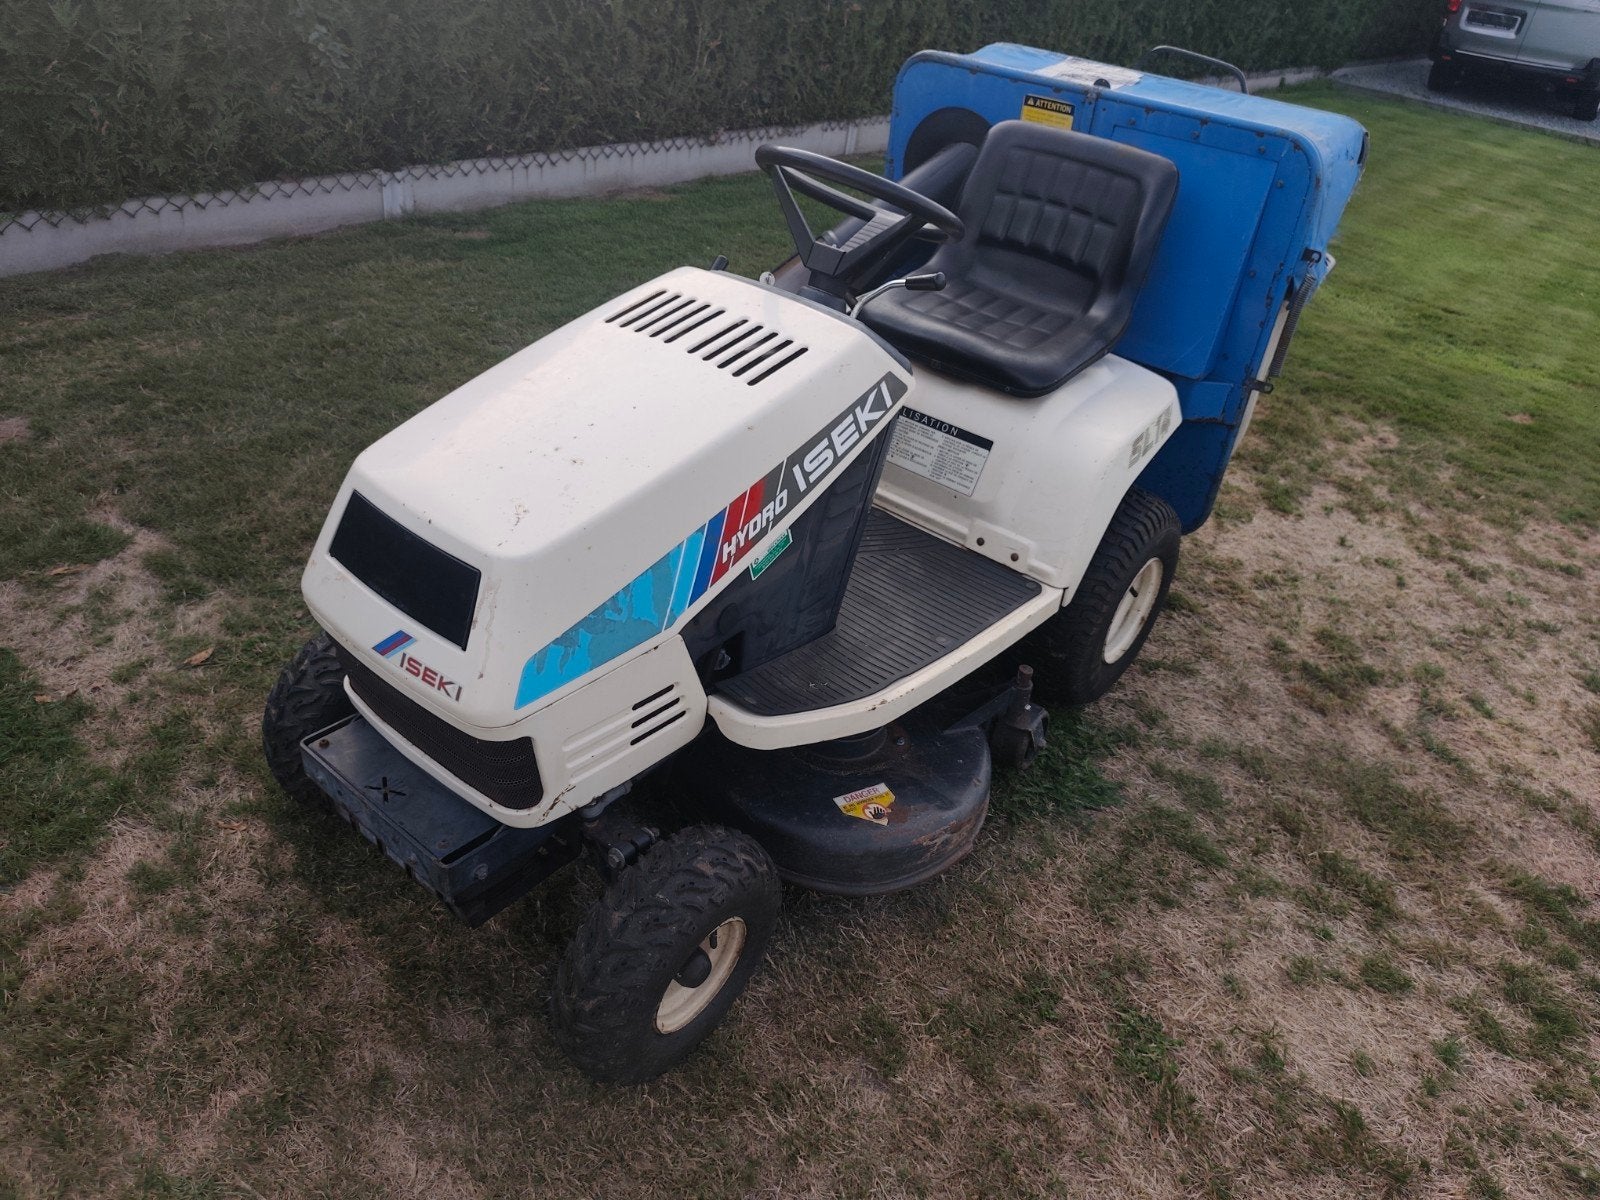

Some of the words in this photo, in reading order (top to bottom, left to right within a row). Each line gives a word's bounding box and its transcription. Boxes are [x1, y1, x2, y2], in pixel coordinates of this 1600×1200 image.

[1035, 98, 1072, 114] ATTENTION
[792, 380, 893, 493] ISEKI
[721, 488, 788, 564] HYDRO
[400, 652, 463, 702] ISEKI
[842, 786, 880, 803] DANGER
